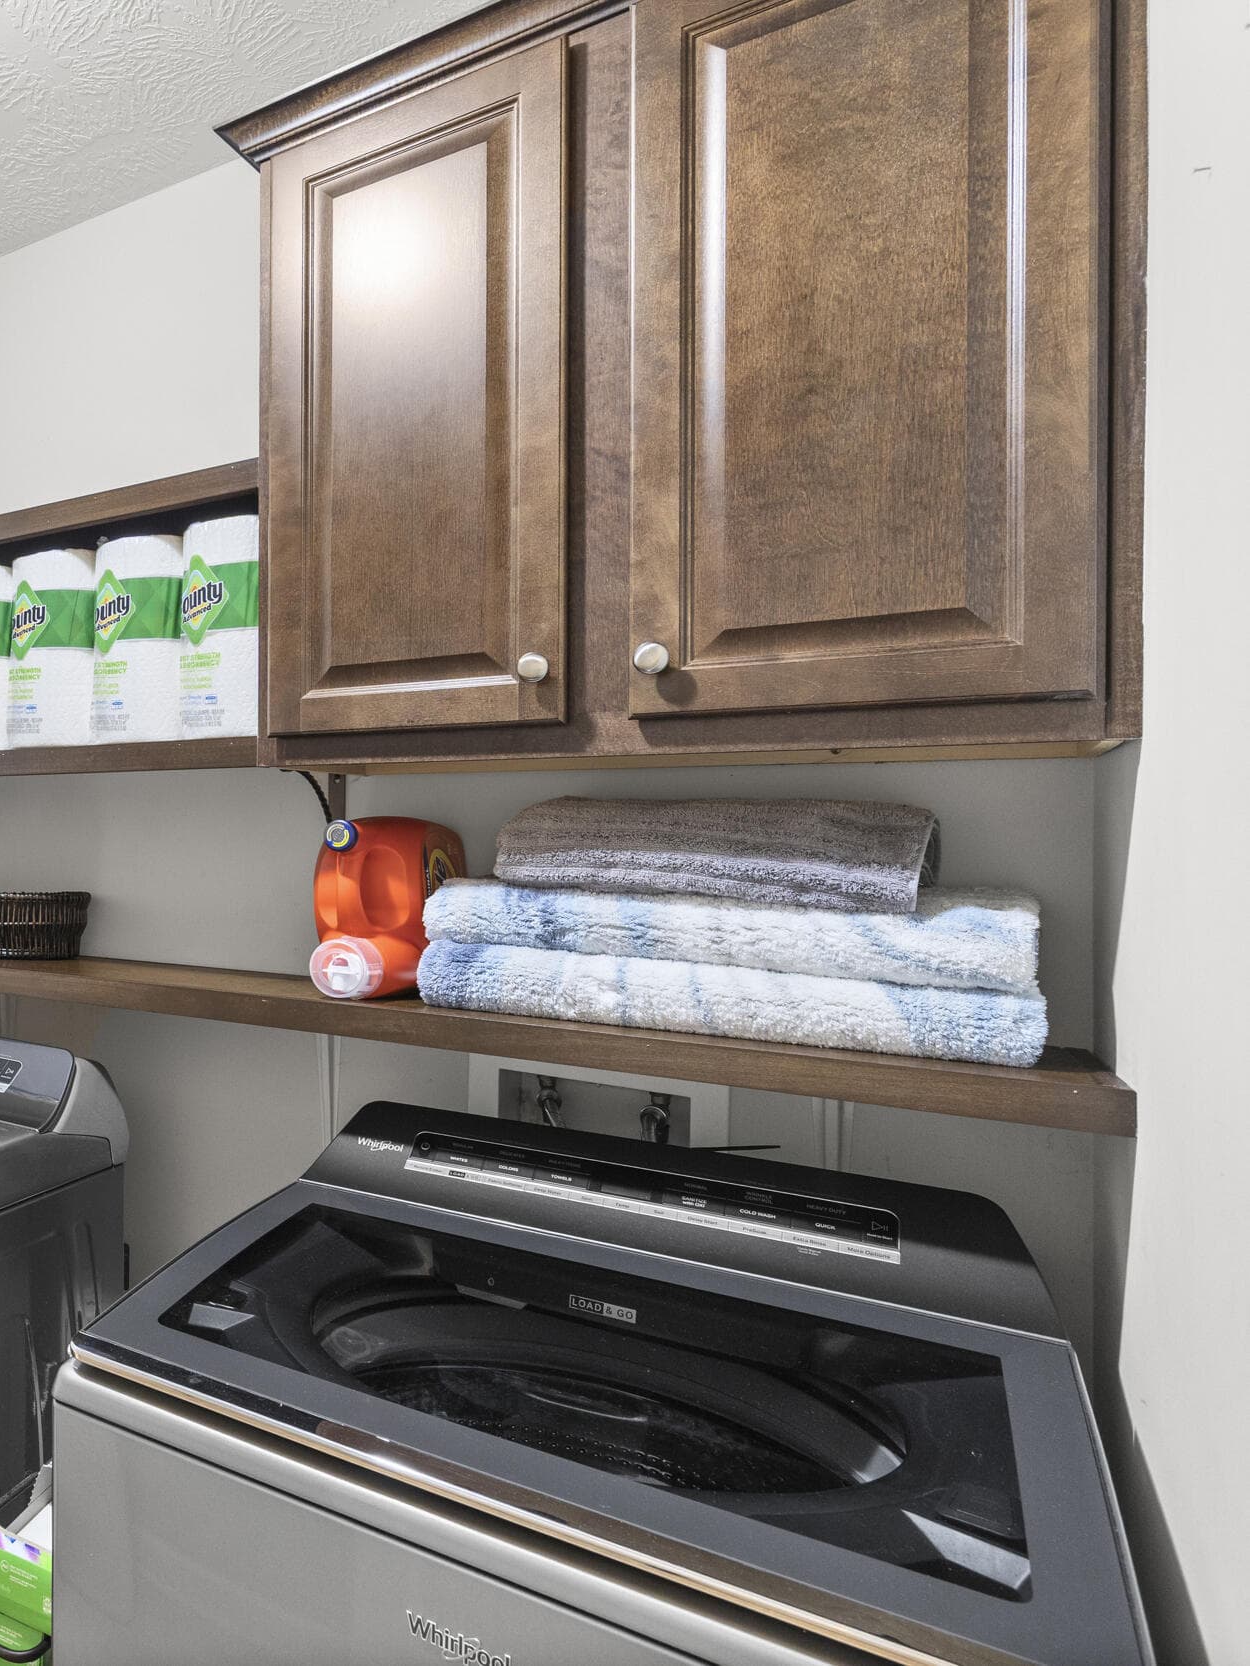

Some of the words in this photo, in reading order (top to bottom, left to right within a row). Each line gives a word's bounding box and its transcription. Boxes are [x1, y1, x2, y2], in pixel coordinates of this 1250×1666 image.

[183, 581, 222, 614] ounty
[13, 605, 46, 629] unty
[95, 595, 130, 623] ounty
[13, 623, 35, 639] dvanced
[357, 1136, 404, 1152] Whirlpool
[498, 1164, 519, 1172] COLORS
[551, 1174, 573, 1182] TOWELS
[739, 1208, 757, 1216] COLD
[757, 1211, 777, 1219] WASH
[815, 1222, 836, 1231] QUICK
[572, 1297, 601, 1312] LOAD
[606, 1306, 612, 1315] &
[617, 1309, 634, 1320] GO
[406, 1609, 510, 1666] Whirlpool
